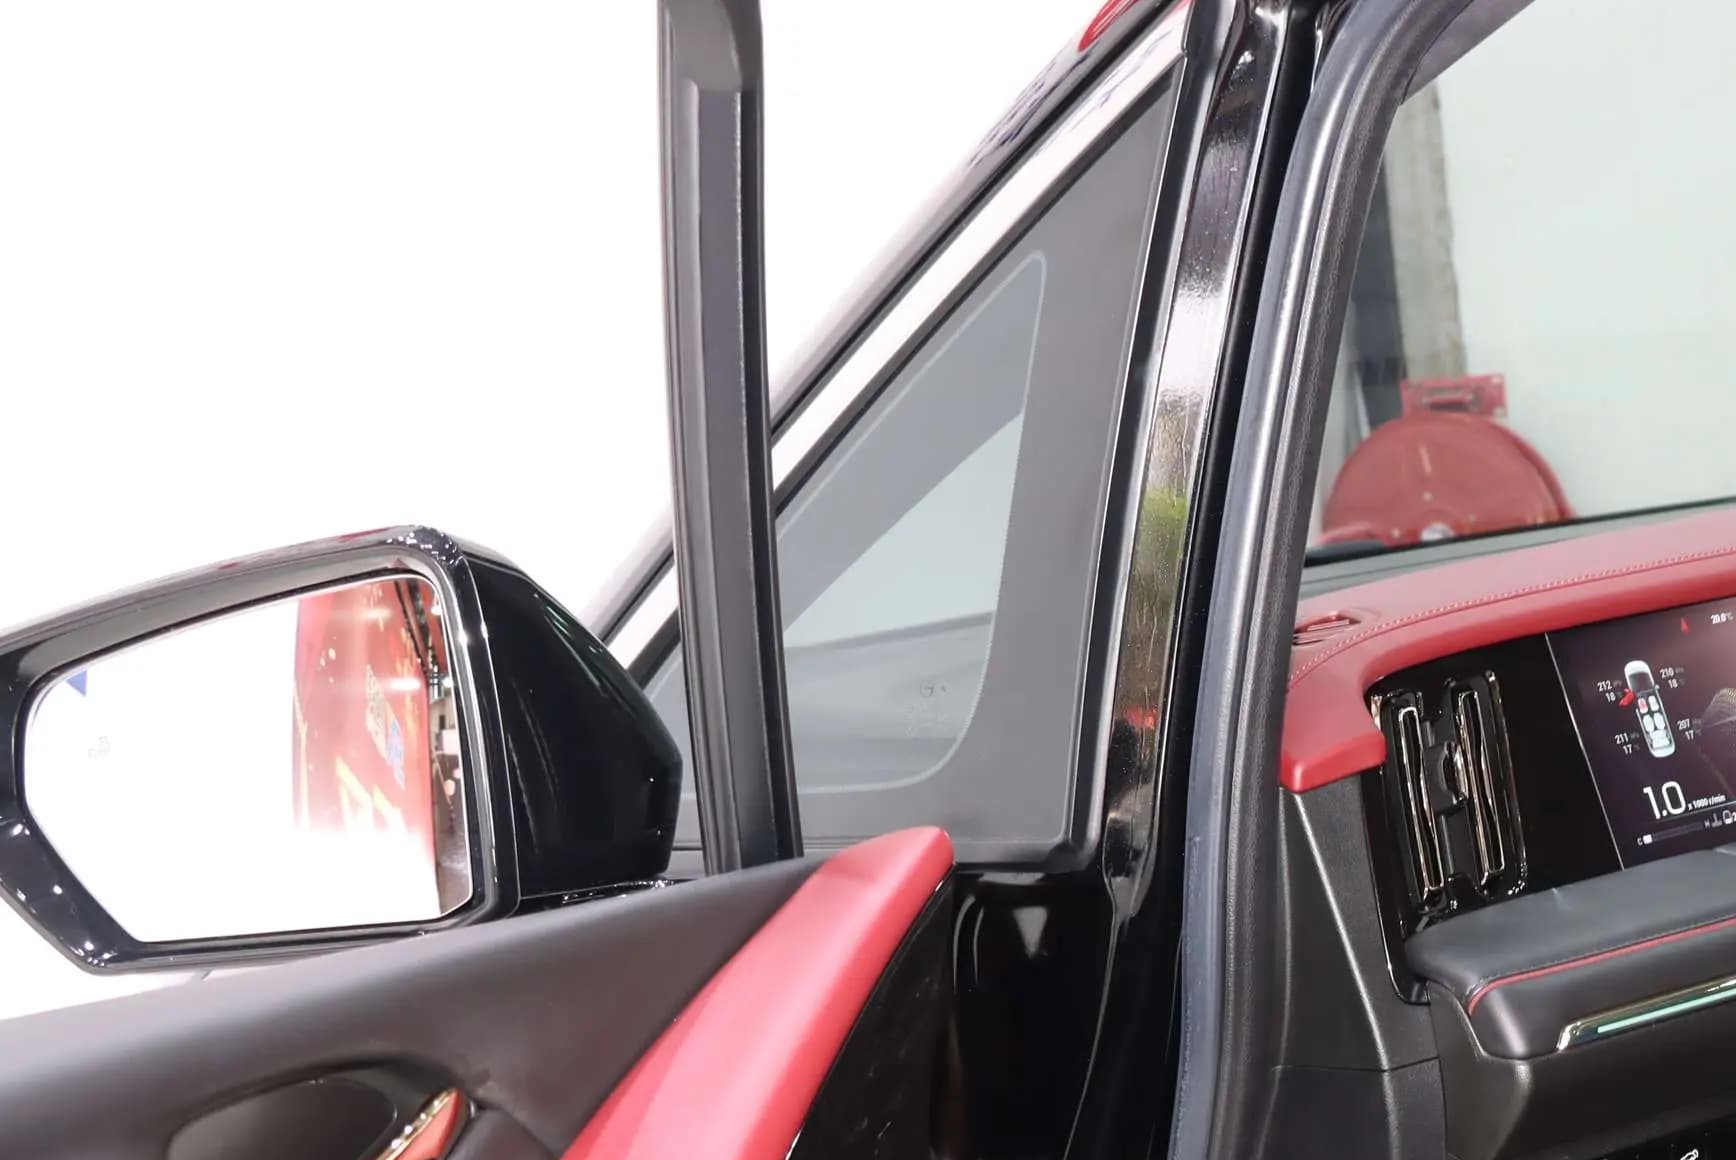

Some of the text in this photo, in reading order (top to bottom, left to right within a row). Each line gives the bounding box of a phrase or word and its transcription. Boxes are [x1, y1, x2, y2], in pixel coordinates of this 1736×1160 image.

[1597, 680, 1613, 692] 212
[1614, 732, 1629, 745] 211
[1623, 744, 1633, 755] 17
[1643, 781, 1686, 820] 1.0
